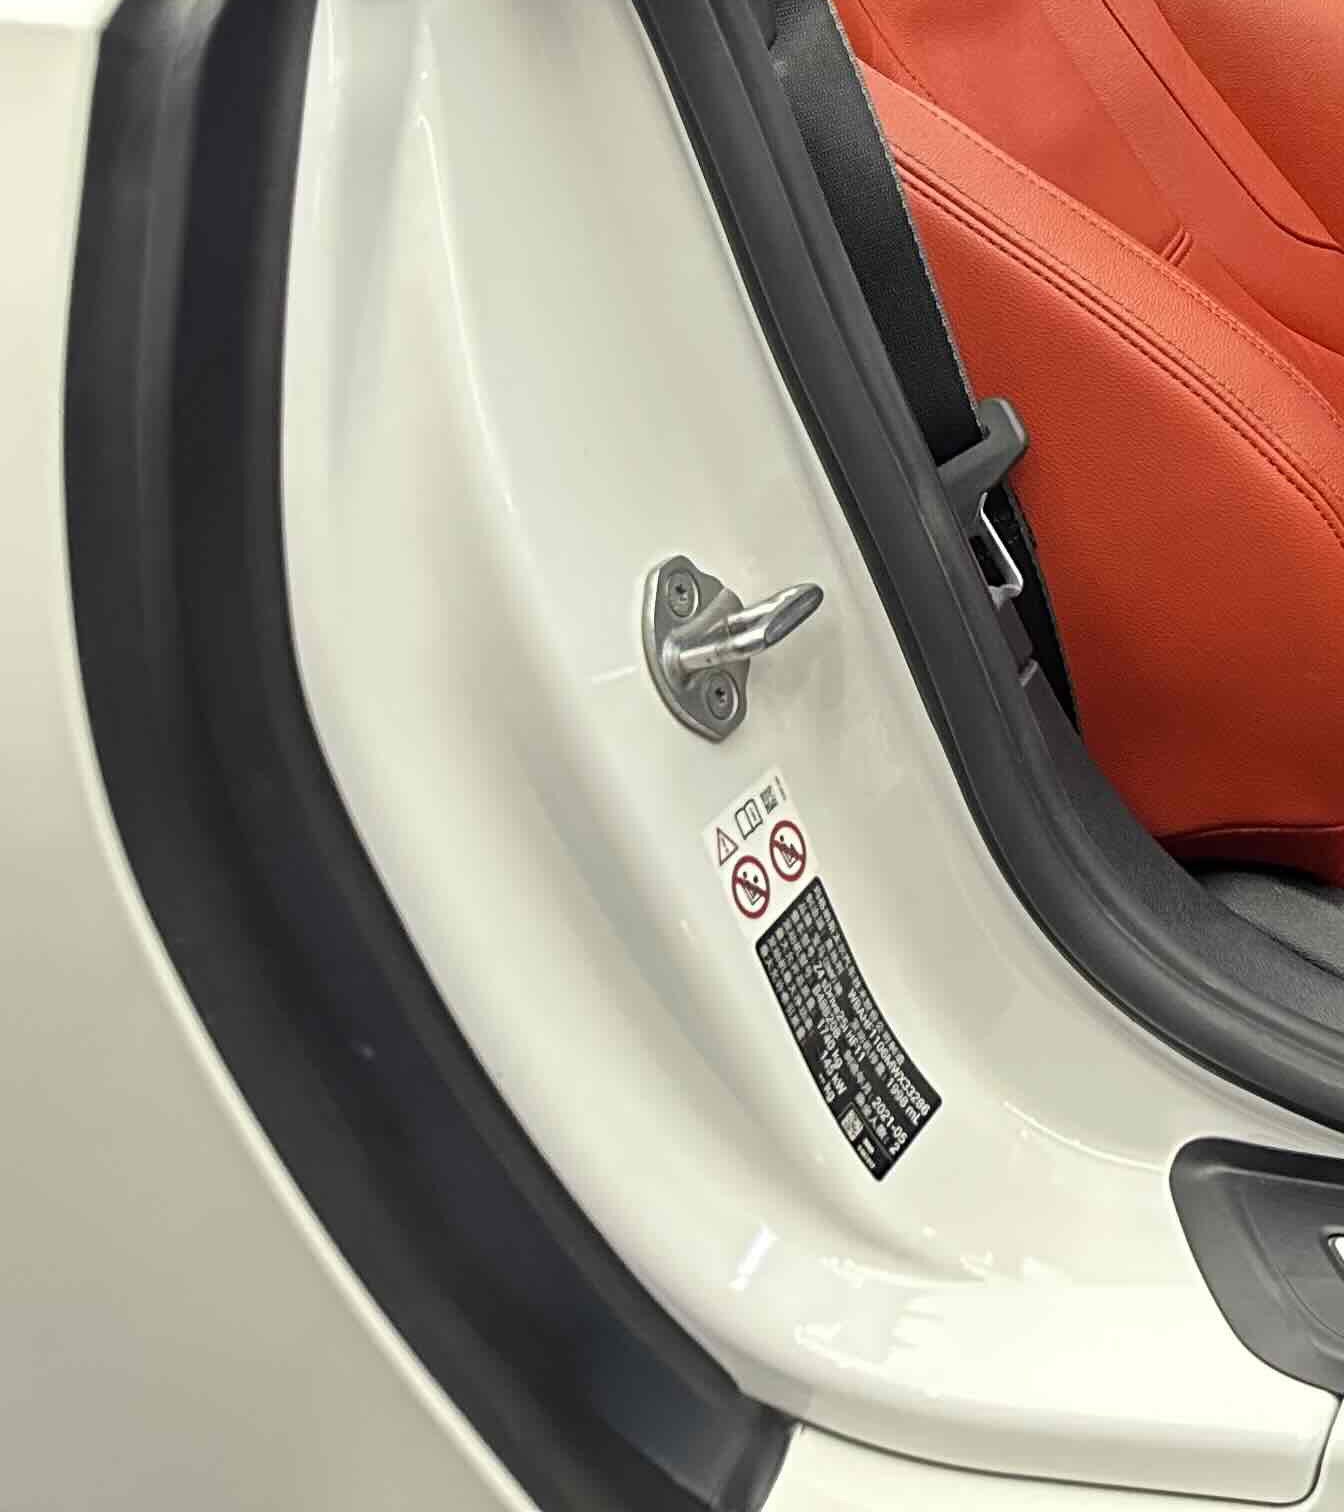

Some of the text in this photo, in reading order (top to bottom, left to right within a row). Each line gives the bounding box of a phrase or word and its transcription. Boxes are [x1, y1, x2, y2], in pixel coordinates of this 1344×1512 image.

[830, 1070, 847, 1096] kW
[871, 1095, 909, 1145] 2021-05
[903, 1104, 922, 1126] mL
